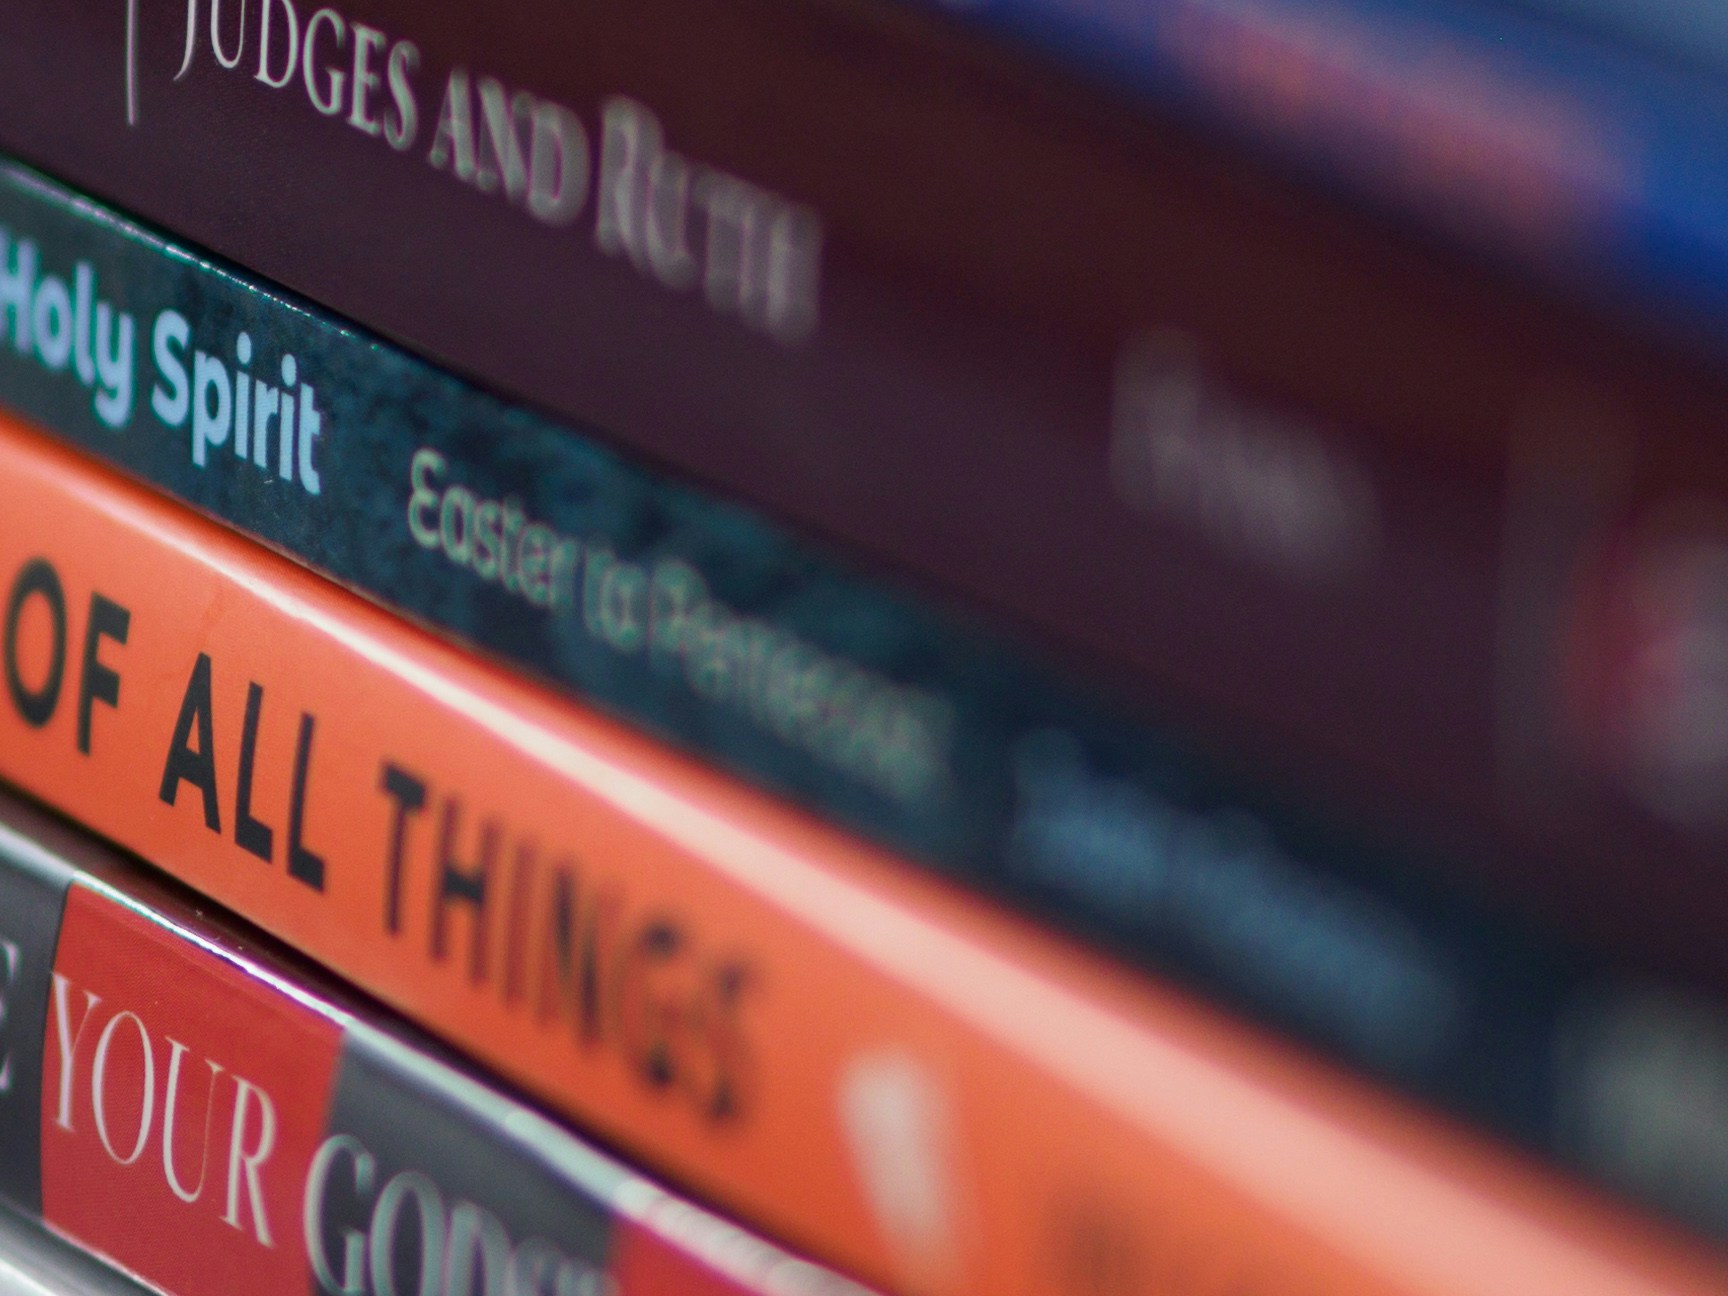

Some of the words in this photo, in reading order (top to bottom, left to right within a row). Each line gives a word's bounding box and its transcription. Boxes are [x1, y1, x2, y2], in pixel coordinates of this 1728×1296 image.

[149, 309, 321, 495] Spirit
[407, 448, 578, 608] Easter
[2, 557, 132, 756] OF
[158, 650, 329, 896] ALL
[376, 758, 756, 1128] THINGS
[48, 968, 277, 1250] YOUR
